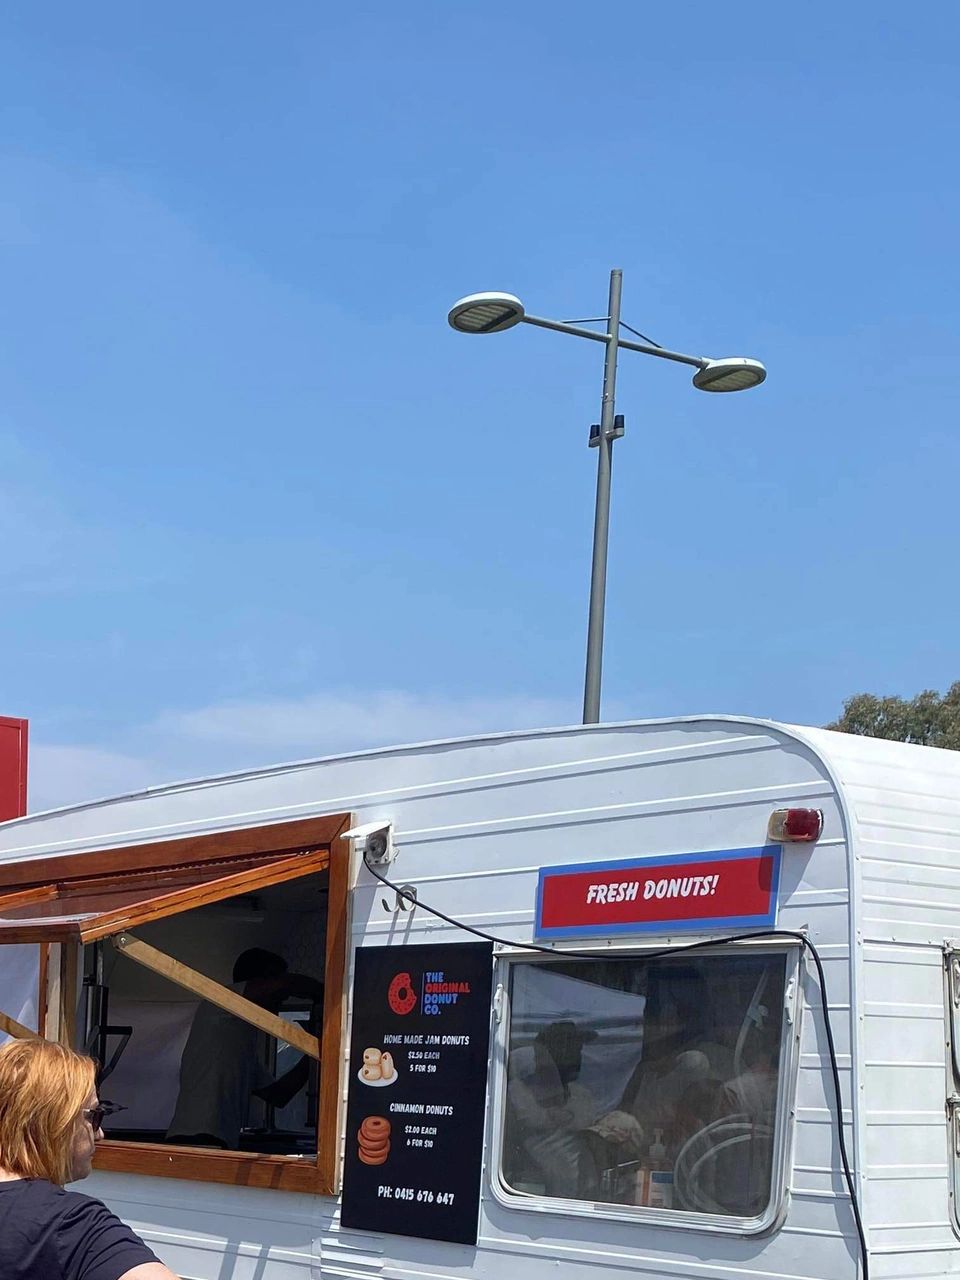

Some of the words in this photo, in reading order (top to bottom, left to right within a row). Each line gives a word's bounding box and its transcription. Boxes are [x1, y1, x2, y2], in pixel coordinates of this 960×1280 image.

[586, 881, 640, 905] FRESH
[643, 874, 720, 900] DONUTS!
[425, 971, 444, 983] THE
[424, 982, 471, 993] ORIGINAL
[423, 993, 458, 1004] DONUT
[423, 1004, 441, 1015] CO.
[383, 1034, 403, 1044] HOME
[403, 1034, 423, 1045] MADE
[424, 1035, 440, 1045] JAM
[441, 1035, 470, 1046] DONUTS
[423, 1051, 440, 1060] EACH
[414, 1064, 426, 1073] FOR
[389, 1102, 424, 1114] CINNAMON
[425, 1104, 454, 1116] DONUTS
[420, 1126, 437, 1135] EACH
[411, 1139, 423, 1147] FOR
[377, 1185, 393, 1198] PH:
[394, 1187, 414, 1201] 0415
[416, 1190, 434, 1203] 676
[436, 1192, 455, 1205] 647
